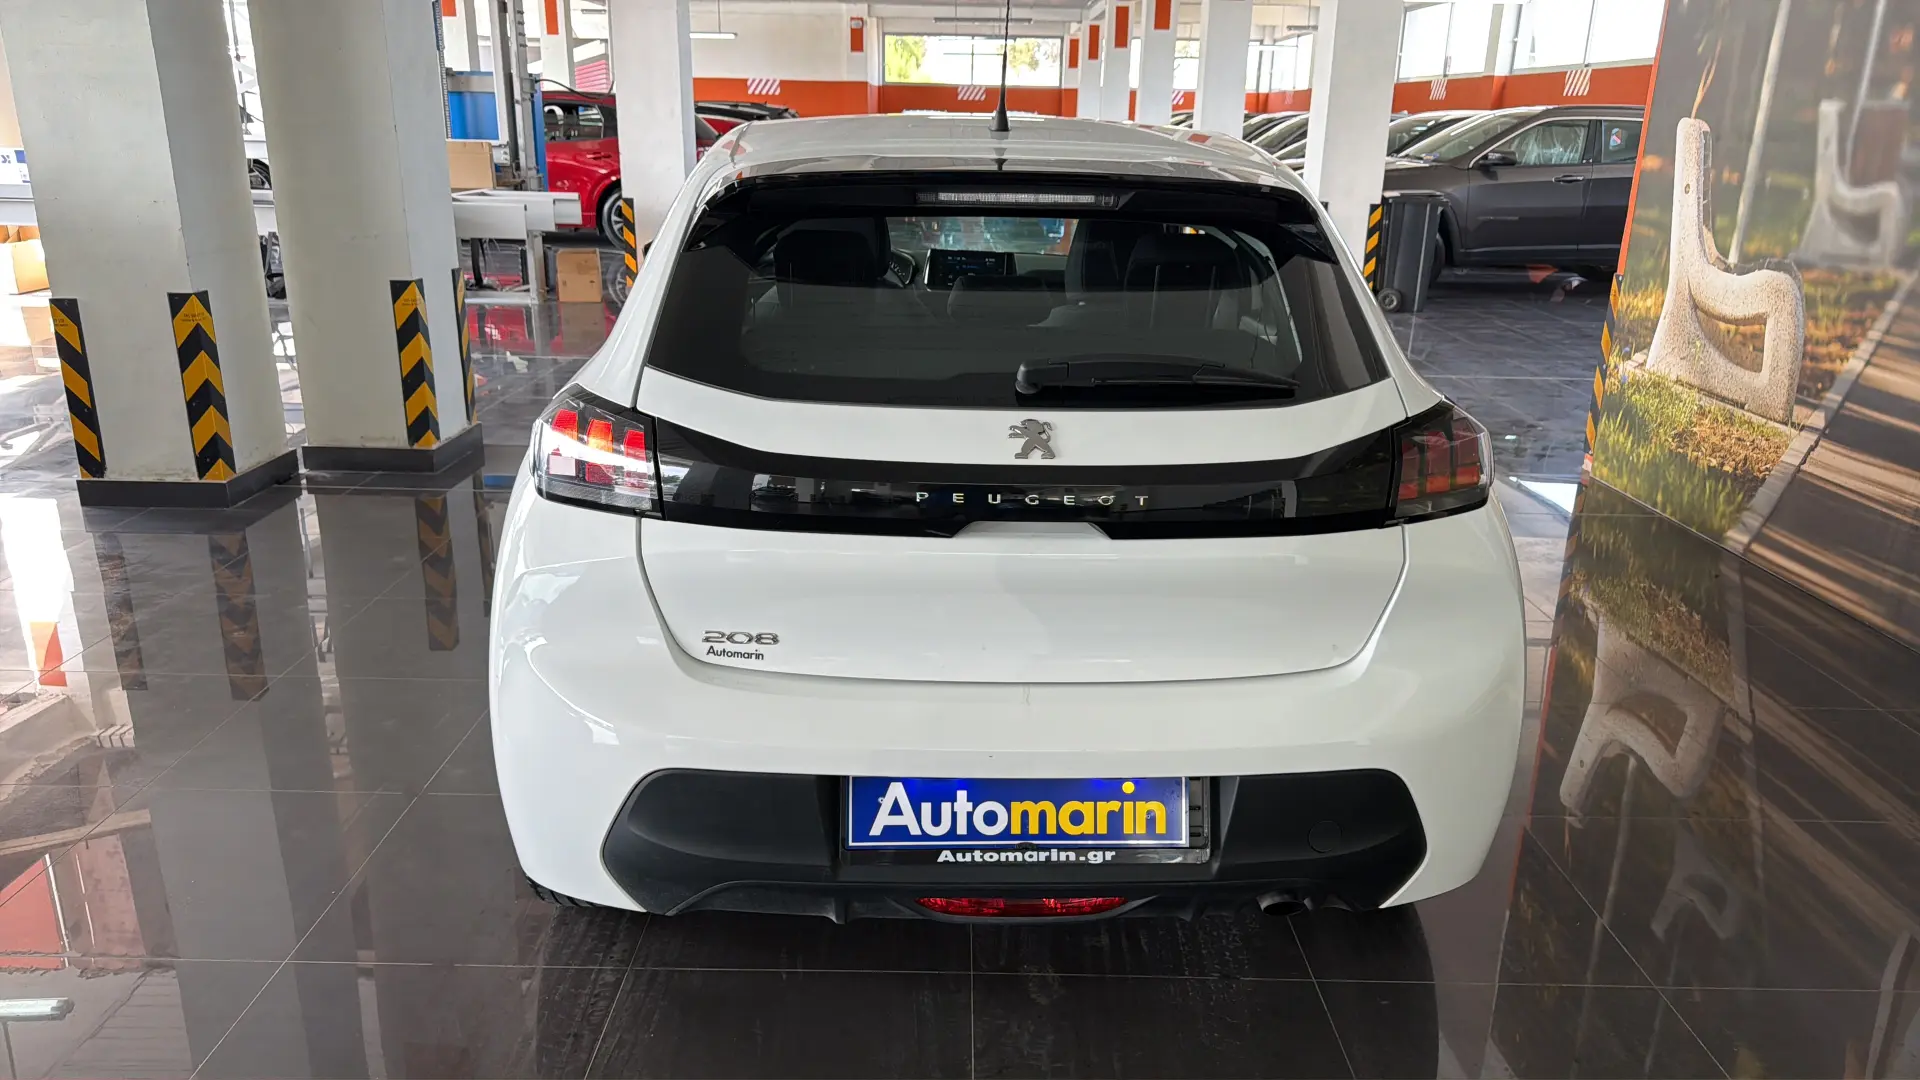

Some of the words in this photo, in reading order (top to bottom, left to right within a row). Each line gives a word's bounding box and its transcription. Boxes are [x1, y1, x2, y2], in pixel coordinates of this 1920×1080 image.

[915, 491, 1149, 506] PEUGEOT
[702, 630, 779, 645] 208
[706, 645, 764, 660] Automarin
[868, 781, 1167, 836] Automarin
[937, 849, 1116, 864] Automarin.gr
